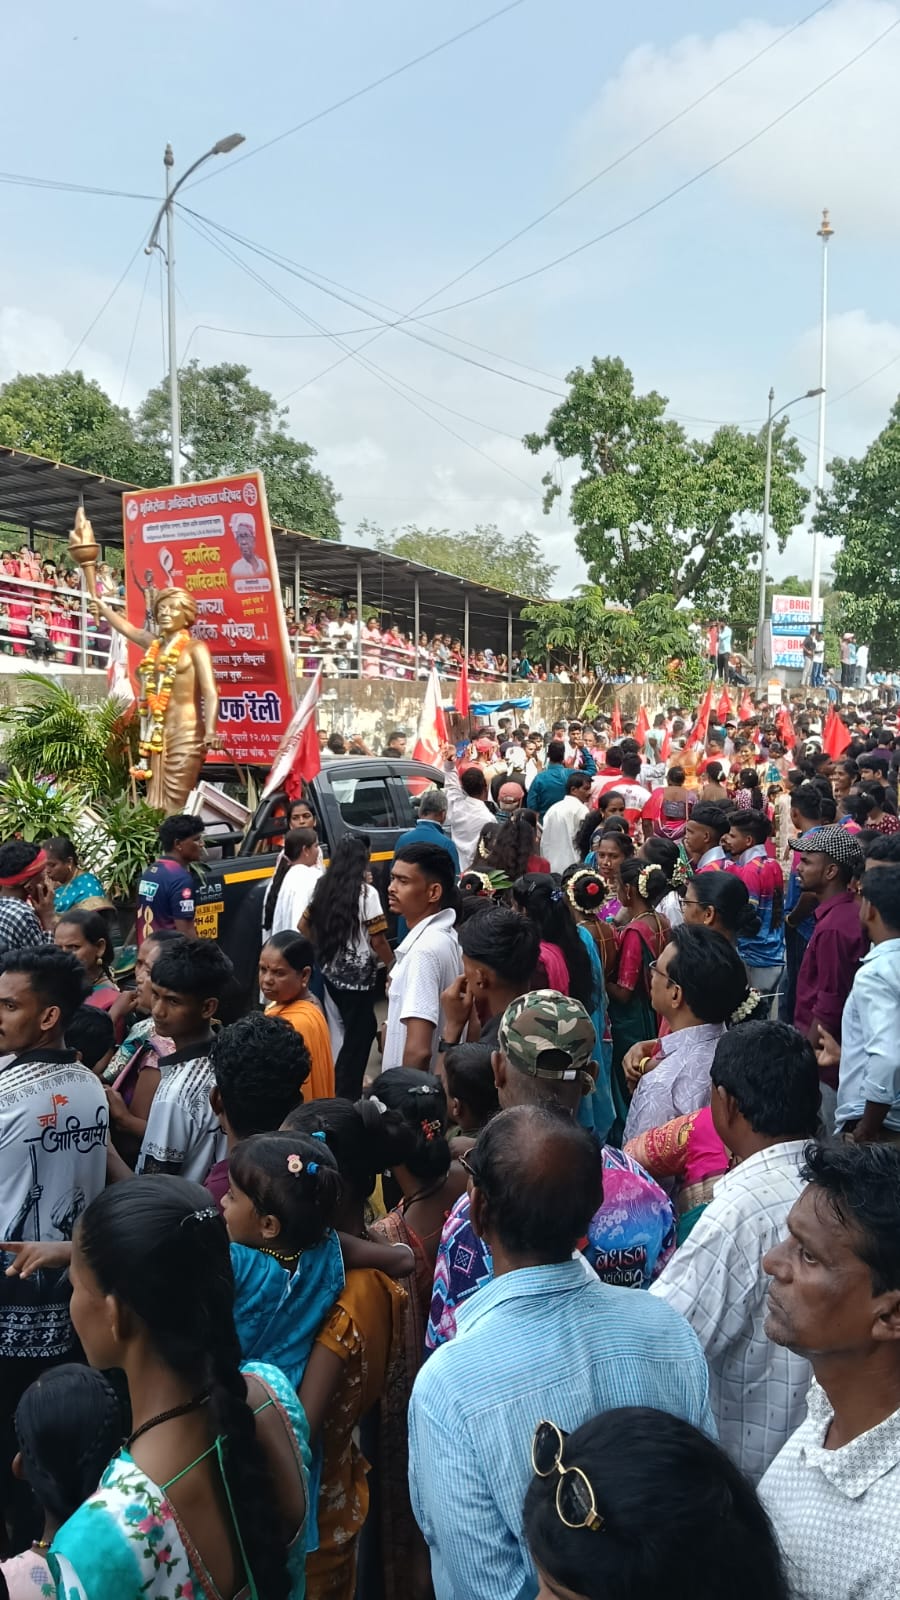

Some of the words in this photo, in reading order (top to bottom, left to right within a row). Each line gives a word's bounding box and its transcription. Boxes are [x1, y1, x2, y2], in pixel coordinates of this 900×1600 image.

[167, 494, 196, 511] आदिवासी
[197, 495, 219, 507] एकता
[219, 487, 242, 504] परिषद
[182, 543, 221, 568] जागतिक
[185, 568, 229, 592] आदिवासी
[789, 599, 811, 610] BRIG
[219, 697, 246, 722] एक
[244, 691, 281, 723] रॅली
[36, 1112, 57, 1129] जय
[38, 1106, 110, 1154] आदिवासी
